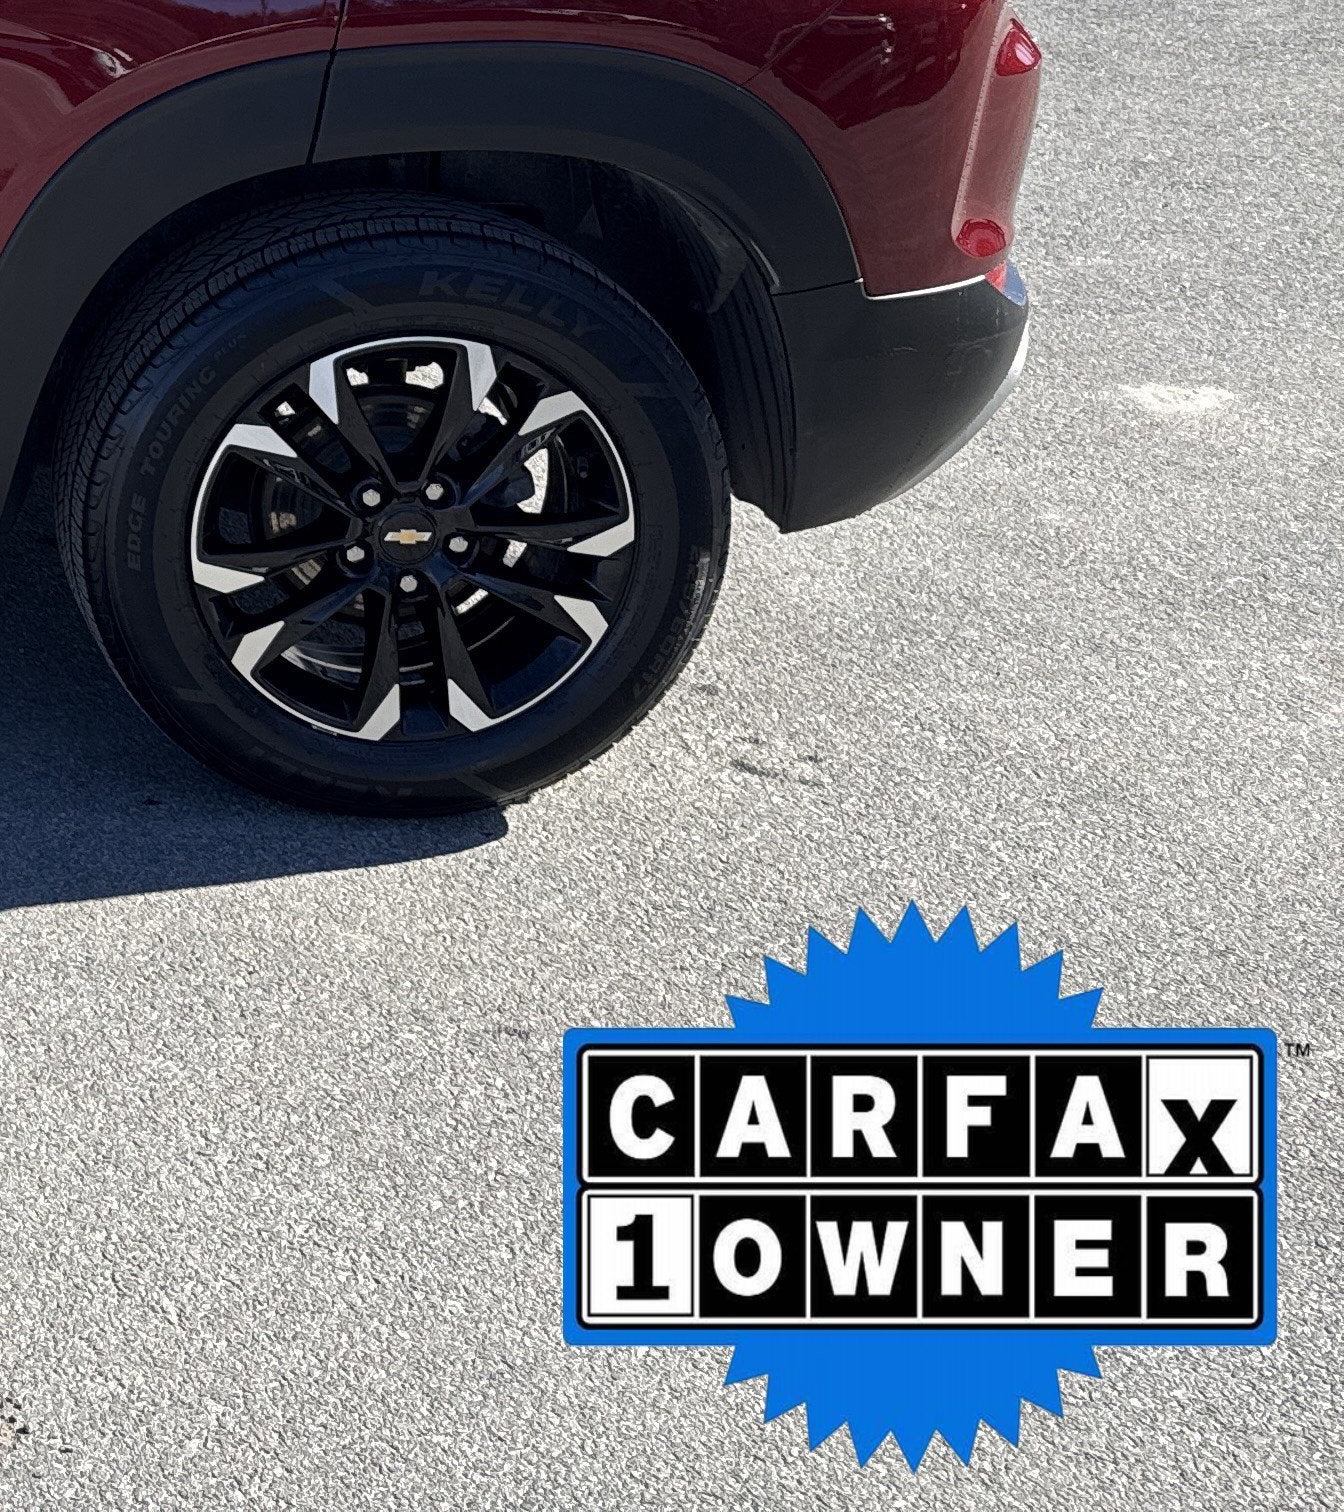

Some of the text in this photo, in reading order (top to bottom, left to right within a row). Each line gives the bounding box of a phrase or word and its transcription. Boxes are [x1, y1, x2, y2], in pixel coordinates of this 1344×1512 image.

[418, 270, 605, 338] KELLY
[127, 491, 147, 571] EDGE
[140, 365, 217, 476] TOURING
